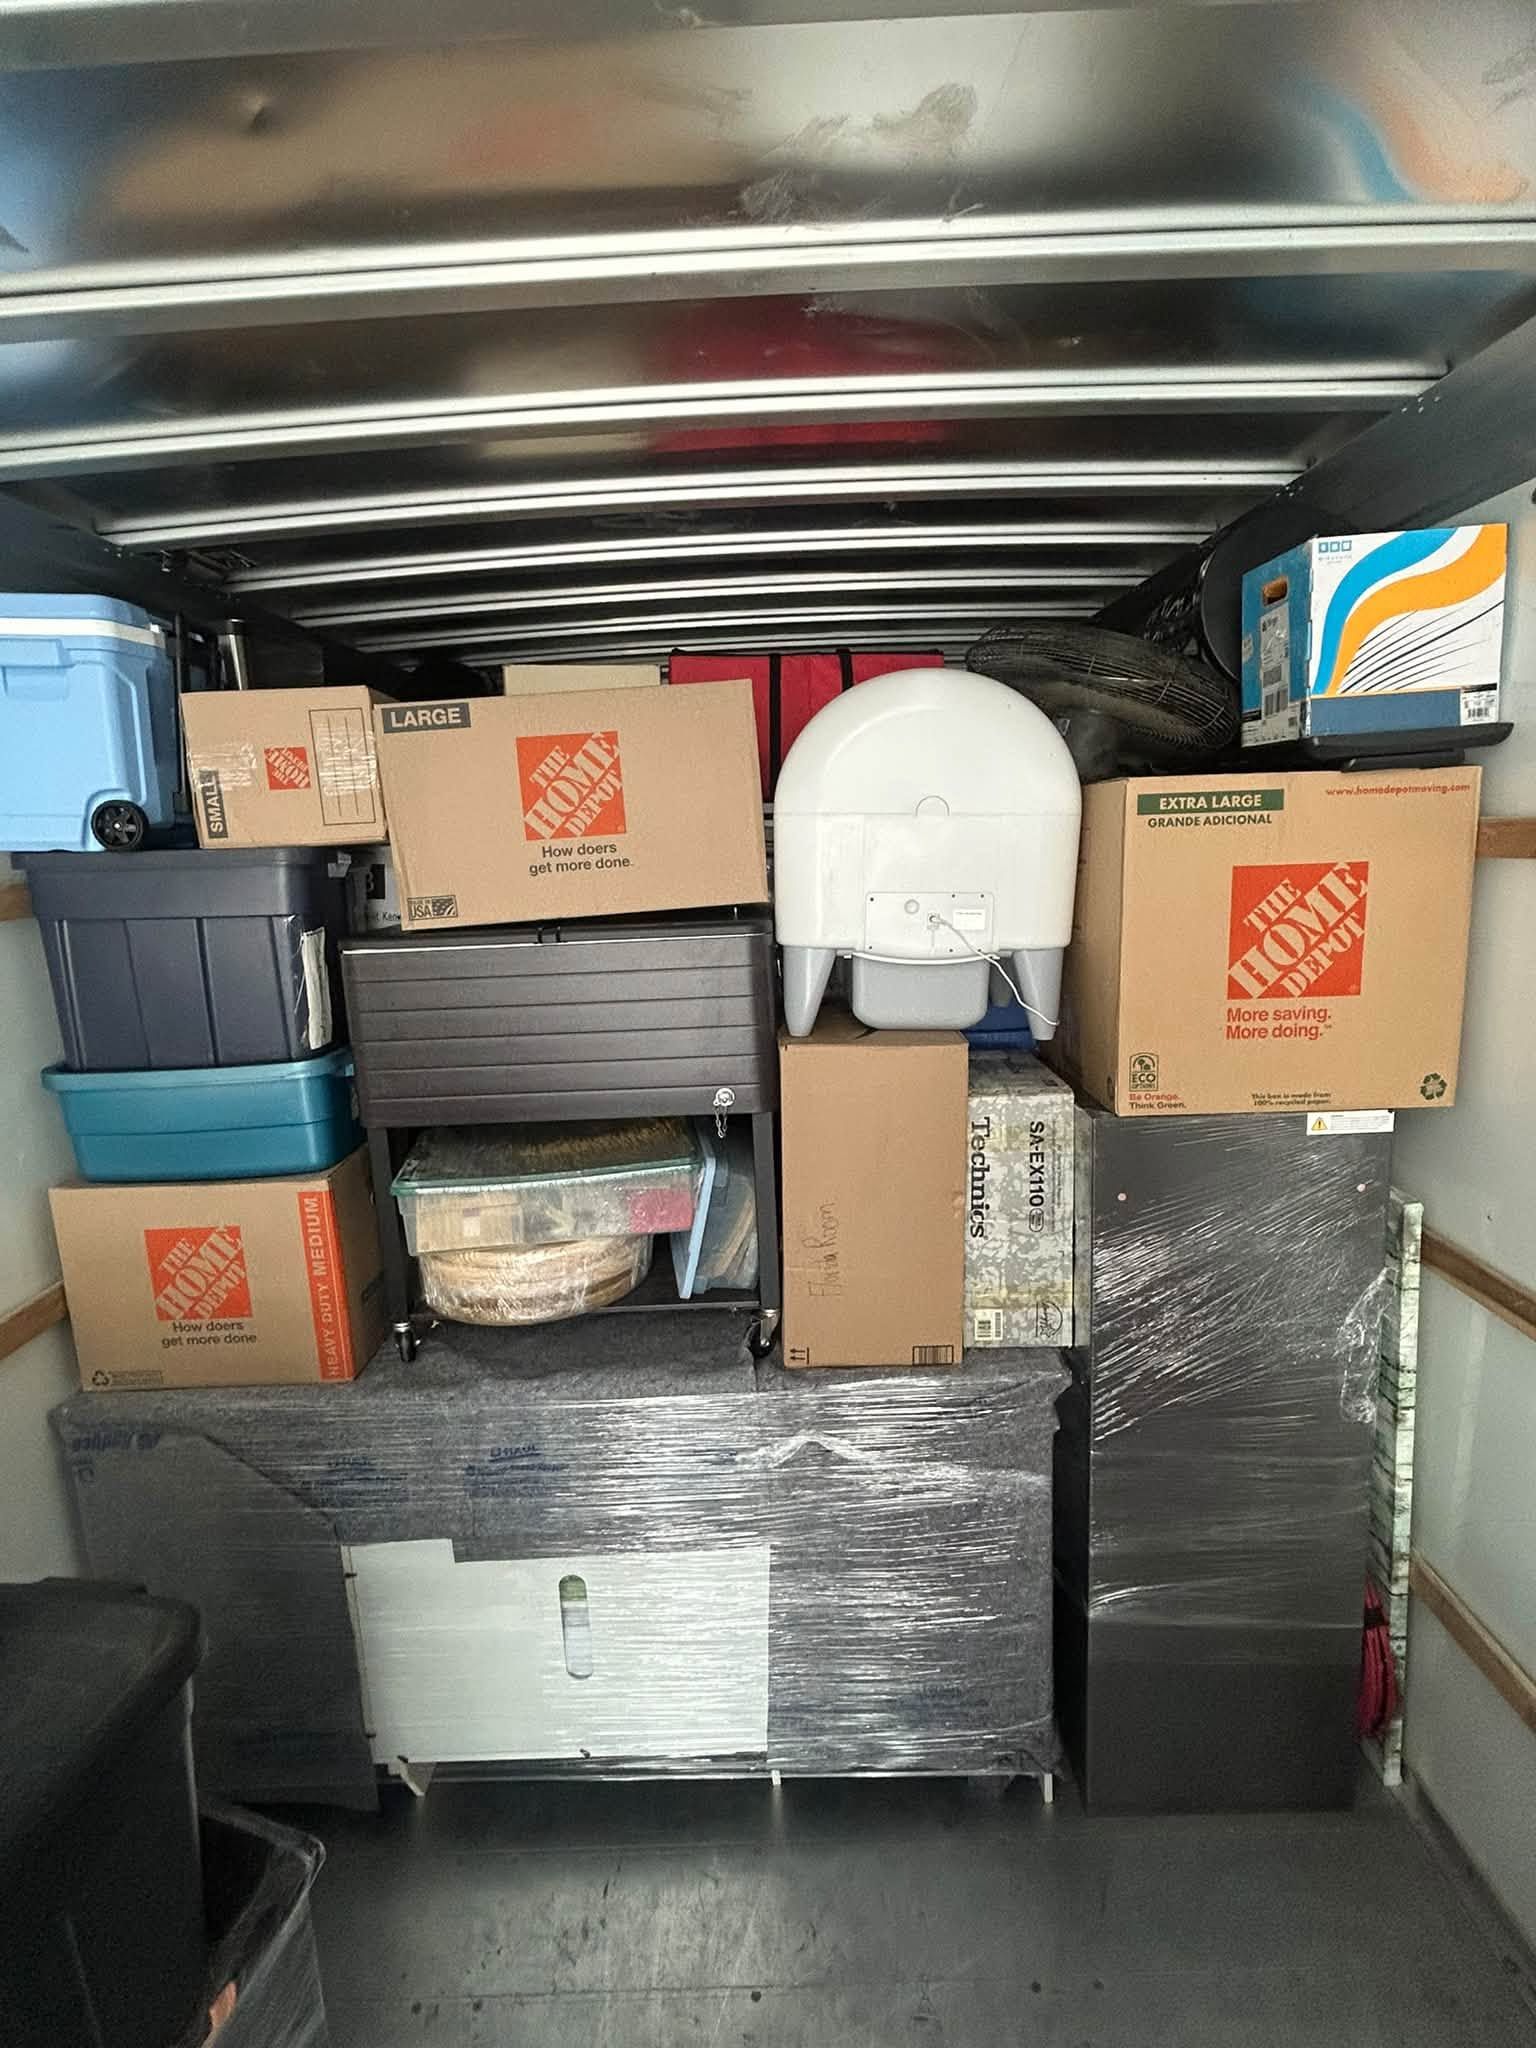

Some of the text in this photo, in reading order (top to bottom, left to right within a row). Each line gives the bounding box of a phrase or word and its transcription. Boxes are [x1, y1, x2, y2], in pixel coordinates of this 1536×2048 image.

[390, 707, 462, 728] LARGE
[529, 745, 570, 788] THE
[523, 731, 622, 839] HOME
[1326, 783, 1471, 796] www.homedepotmoving.com
[203, 774, 224, 833] SMALL
[565, 769, 624, 837] DEPOT
[1159, 794, 1262, 811] EXTRA LARGE
[1147, 813, 1272, 828] GRANDE ADICIONAL
[542, 842, 617, 859] How doers
[529, 861, 552, 876] get
[555, 859, 592, 872] more
[411, 904, 432, 918] USA
[1243, 879, 1301, 934] THE
[1229, 861, 1369, 999] HOME
[1280, 911, 1367, 997] DEPOT
[1226, 1006, 1332, 1023] More saving.
[1226, 1025, 1268, 1039] More
[1132, 1073, 1156, 1083] ECO
[1129, 1093, 1180, 1102] Be Orange.
[1129, 1101, 1187, 1109] Think Green.
[1029, 1121, 1045, 1207] SA-EX110
[970, 1116, 990, 1238] Technics
[158, 1237, 196, 1275] THE
[154, 1225, 244, 1320] HOME
[194, 1260, 247, 1320] DEPOT
[304, 1197, 345, 1377] HEAVY DUTY MEDIUM
[172, 1320, 243, 1332] How doers
[162, 1334, 183, 1348] get
[186, 1334, 221, 1346] more
